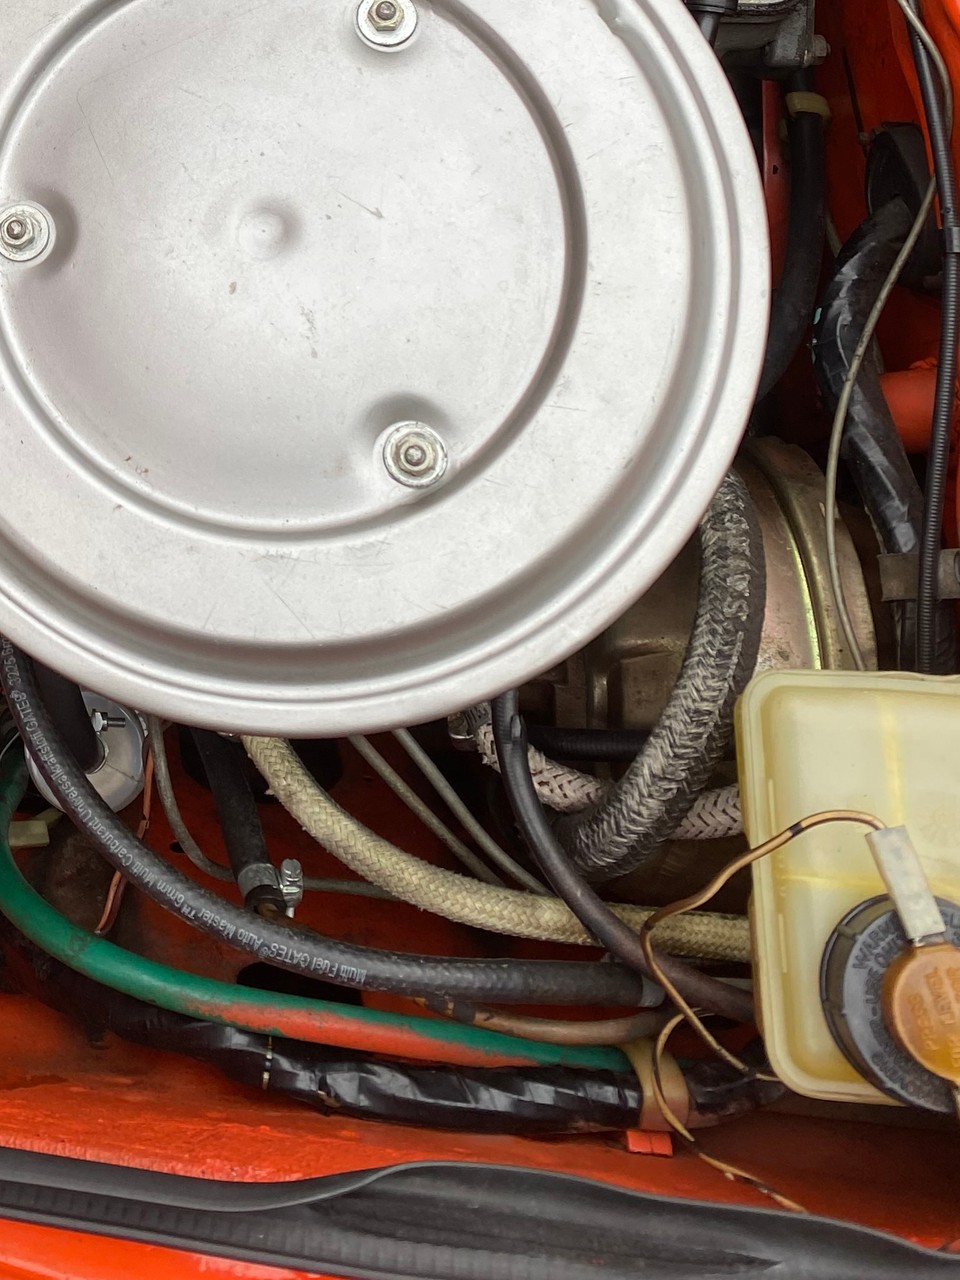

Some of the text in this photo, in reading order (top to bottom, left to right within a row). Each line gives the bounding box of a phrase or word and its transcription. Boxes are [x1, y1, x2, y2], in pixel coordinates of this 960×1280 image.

[89, 815, 133, 868] Carburant
[130, 859, 157, 883] Multi
[155, 878, 185, 907] 6mm
[197, 907, 236, 939] Master
[237, 927, 264, 952] Auto
[311, 955, 339, 978] Fuel
